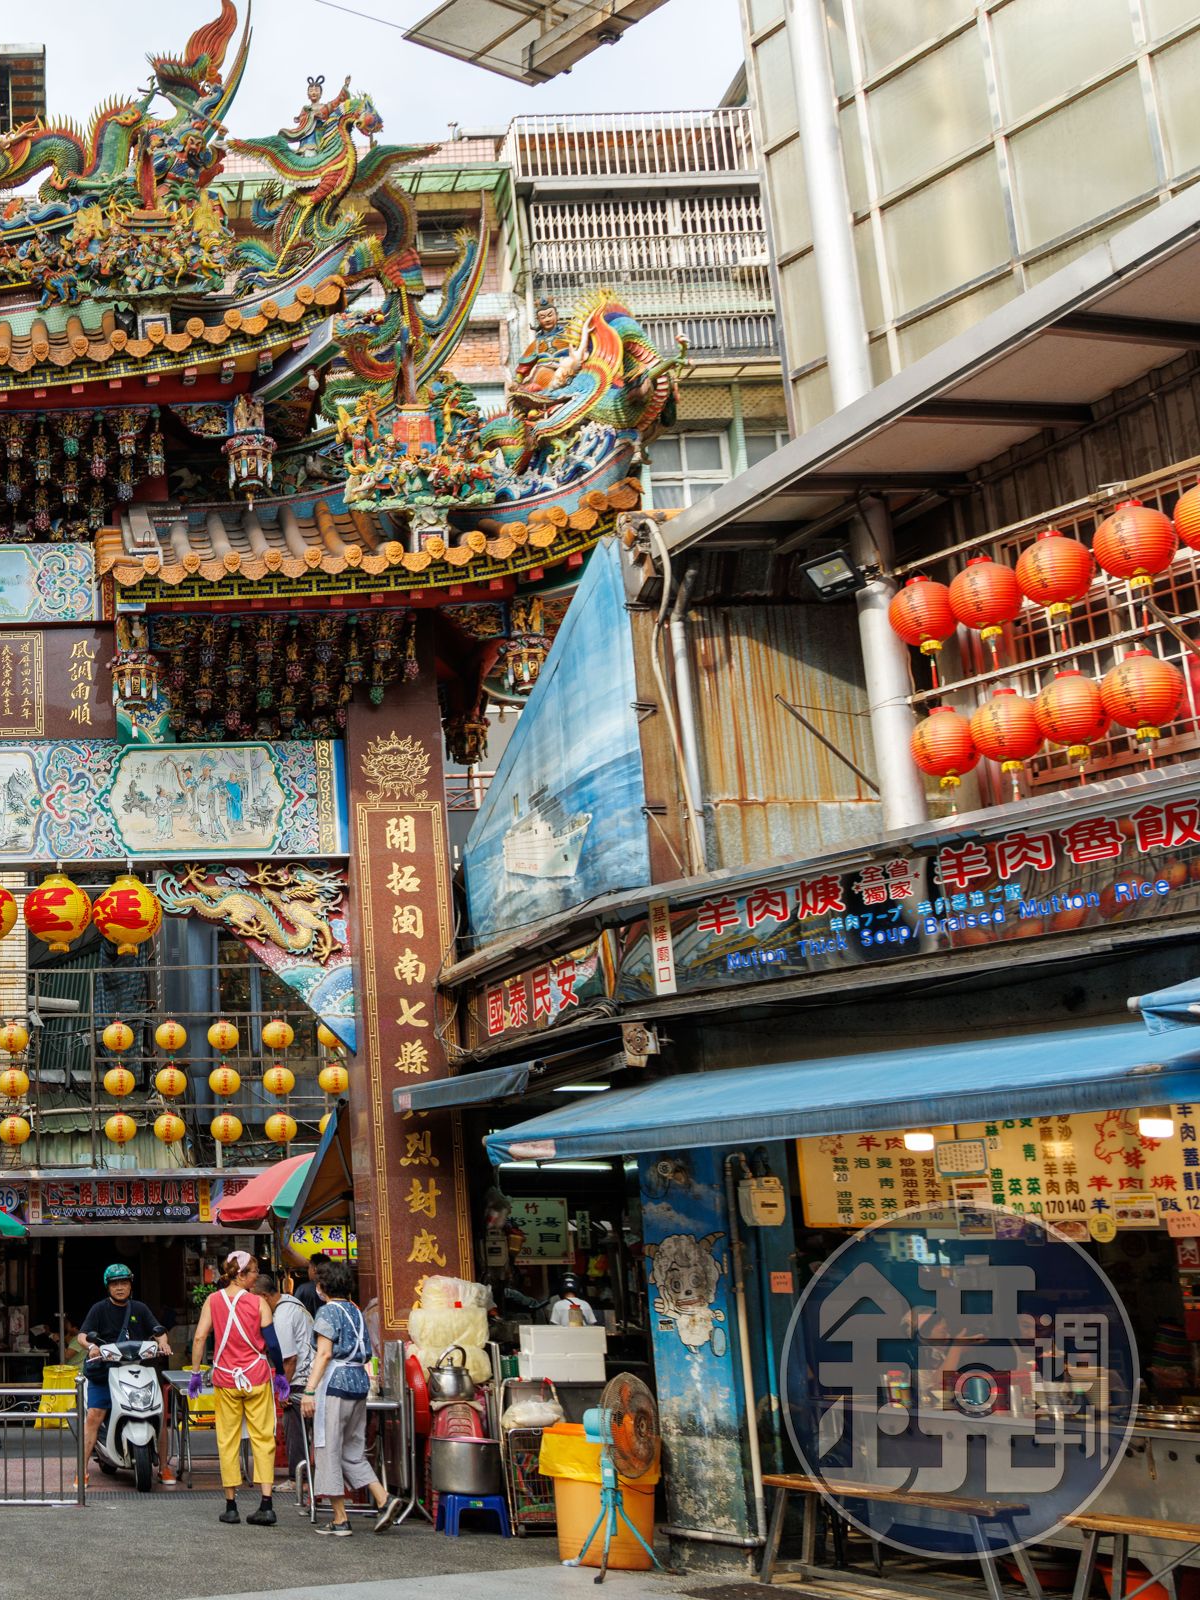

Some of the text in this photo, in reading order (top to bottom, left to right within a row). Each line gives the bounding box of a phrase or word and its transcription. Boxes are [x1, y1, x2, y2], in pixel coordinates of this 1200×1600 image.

[67, 640, 96, 726] 風調雨順
[937, 797, 1200, 888] 羊肉魯飯
[861, 858, 911, 884] 全省
[863, 879, 914, 906] 獨家
[726, 947, 787, 970] Mutton
[797, 932, 849, 958] Thick
[1018, 890, 1101, 920] Mutton
[1114, 879, 1171, 903] Rice
[652, 905, 672, 983] 基隆廟口
[486, 958, 580, 1038] 國泰民安
[384, 814, 446, 1312] 開拓閩南七縣烈封威
[836, 1173, 849, 1182] 20
[45, 1180, 198, 1206] 仁三路廟口攤販小組
[1066, 1199, 1086, 1213] 140
[860, 1211, 877, 1221] 30
[1030, 1201, 1043, 1214] 30
[1045, 1200, 1065, 1214] 170
